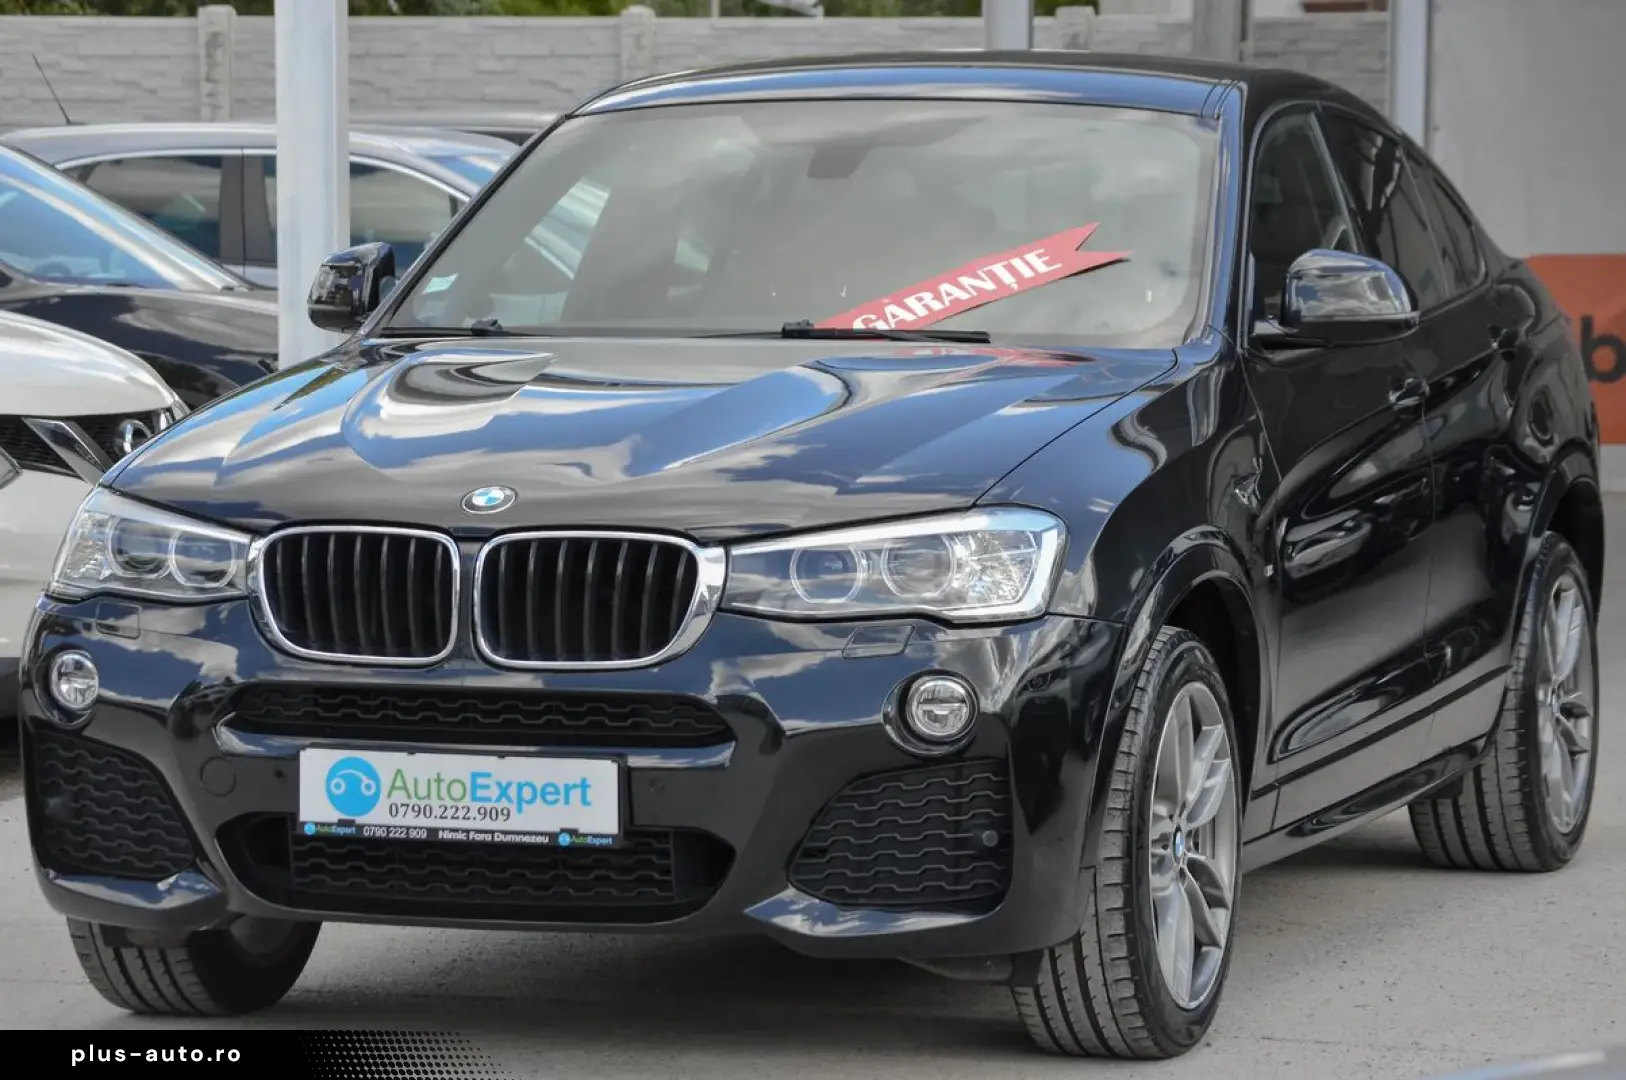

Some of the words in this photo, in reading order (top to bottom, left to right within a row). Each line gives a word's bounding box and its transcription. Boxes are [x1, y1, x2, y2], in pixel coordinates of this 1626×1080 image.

[852, 248, 1062, 330] GARANȚIE
[386, 768, 592, 814] AutoExpert
[388, 803, 511, 822] 0790.222.909
[363, 826, 387, 837] 0790
[388, 827, 407, 838] 222
[408, 828, 427, 839] 909
[438, 829, 467, 840] Nimic
[494, 832, 549, 844] Dumnezeu
[571, 834, 613, 846] AutoExpert
